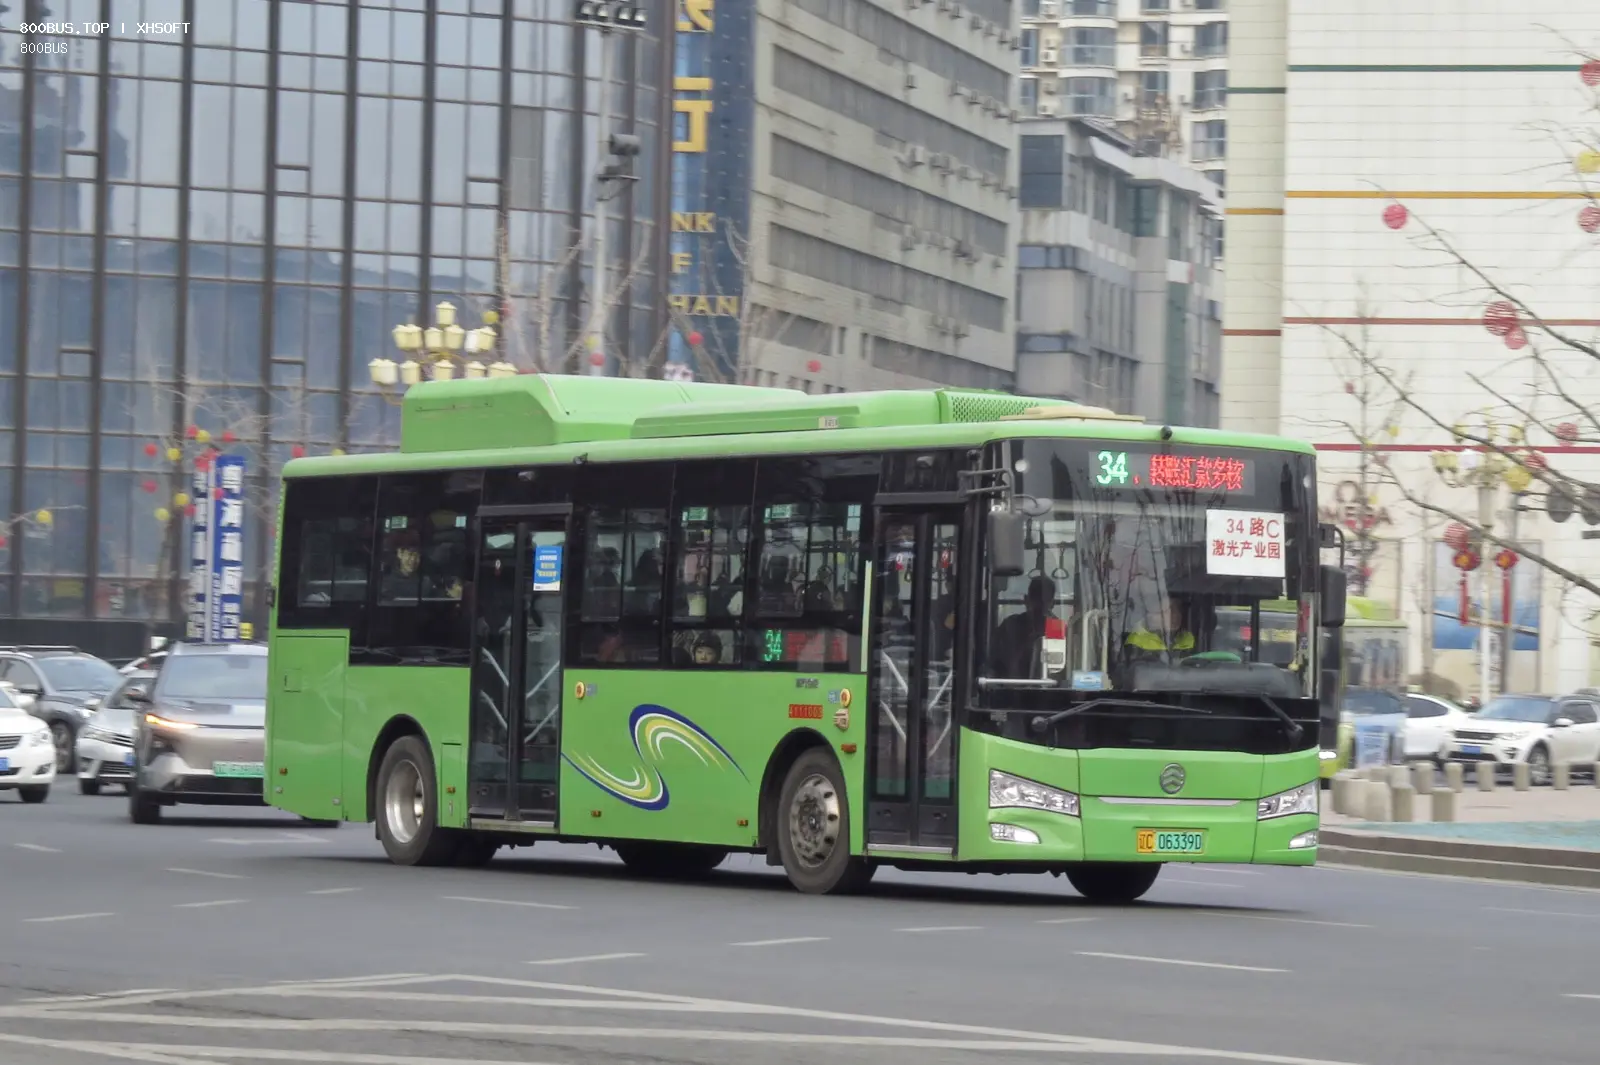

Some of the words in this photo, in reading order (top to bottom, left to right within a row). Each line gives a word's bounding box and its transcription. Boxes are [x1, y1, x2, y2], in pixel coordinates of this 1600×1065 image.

[671, 212, 716, 233] NK
[1096, 451, 1128, 484] 34
[1212, 539, 1281, 559] 激光产业园
[764, 629, 782, 662] 34
